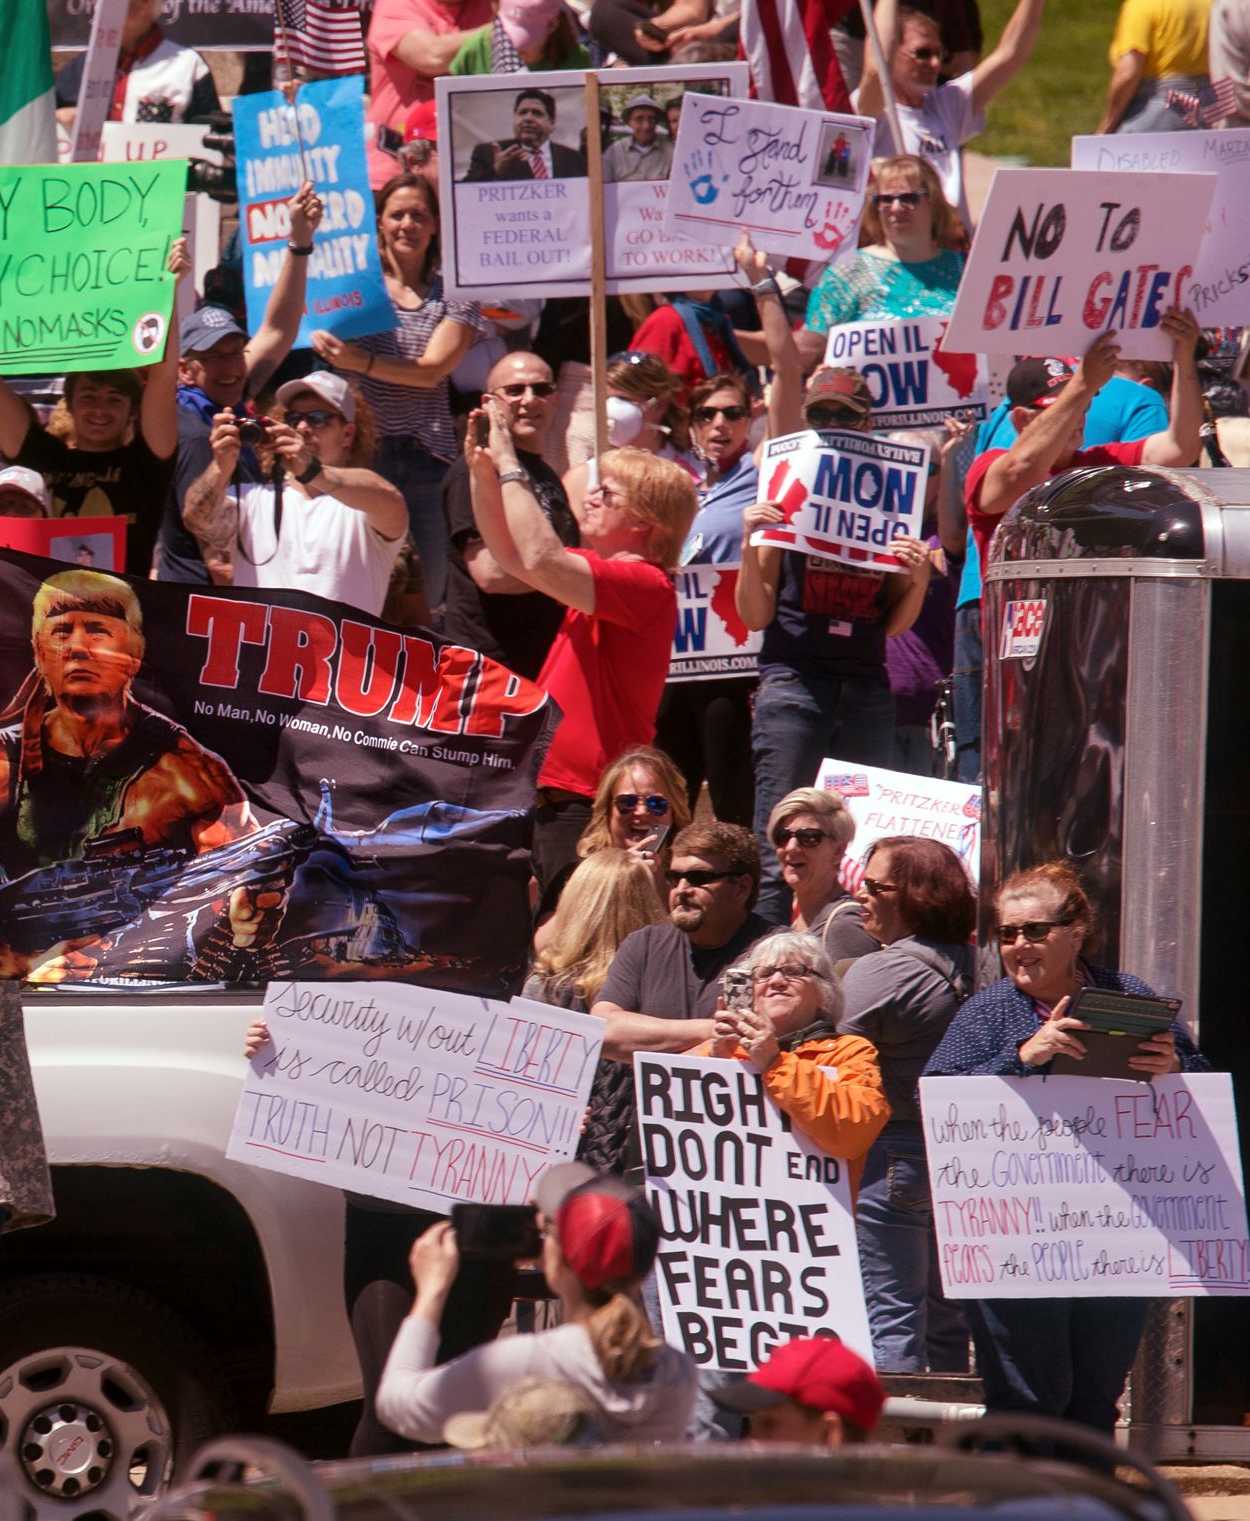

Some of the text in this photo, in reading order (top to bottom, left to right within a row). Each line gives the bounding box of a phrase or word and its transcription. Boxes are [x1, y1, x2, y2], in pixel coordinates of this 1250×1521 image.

[228, 0, 276, 14] Ame
[250, 189, 366, 240] NO ERD
[478, 183, 567, 203] PRITZKER
[495, 206, 553, 223] wants a
[483, 228, 567, 245] FEDERAL
[626, 230, 654, 245] GO
[1000, 202, 1142, 262] NO TO
[14, 234, 171, 299] CHOICE!
[480, 249, 571, 268] BAIL OUT!
[623, 249, 716, 266] TO WORK!
[983, 274, 1063, 331] BILL
[833, 325, 929, 358] OPEN IL
[847, 360, 928, 409] OW
[813, 454, 916, 514] NOW
[809, 502, 910, 547] OPEN IL
[684, 572, 708, 599] IL
[186, 593, 549, 738] TRUMP
[670, 656, 758, 675] RILLINOIS.COM
[194, 700, 213, 716] No
[353, 731, 398, 752] Commie
[399, 739, 428, 758] Can
[431, 745, 479, 766] Stump
[482, 753, 516, 770] Him.
[269, 982, 601, 1089] Security w/out LIBERTY
[266, 1039, 577, 1155] is called PRISON!!
[640, 1062, 791, 1133] RIGH
[932, 1090, 1197, 1150] when the people FEAR
[245, 1090, 333, 1157] TRUTH
[336, 1118, 408, 1174] NOT
[643, 1122, 840, 1187] DONT END
[937, 1156, 991, 1189] the
[1113, 1154, 1175, 1184] there
[1183, 1155, 1216, 1184] is
[651, 1189, 841, 1258] WHERE
[1049, 1201, 1095, 1233] when
[1095, 1205, 1131, 1229] the
[656, 1250, 829, 1318] FEARS
[1000, 1253, 1030, 1279] the
[1091, 1250, 1136, 1277] there
[1139, 1253, 1167, 1276] is
